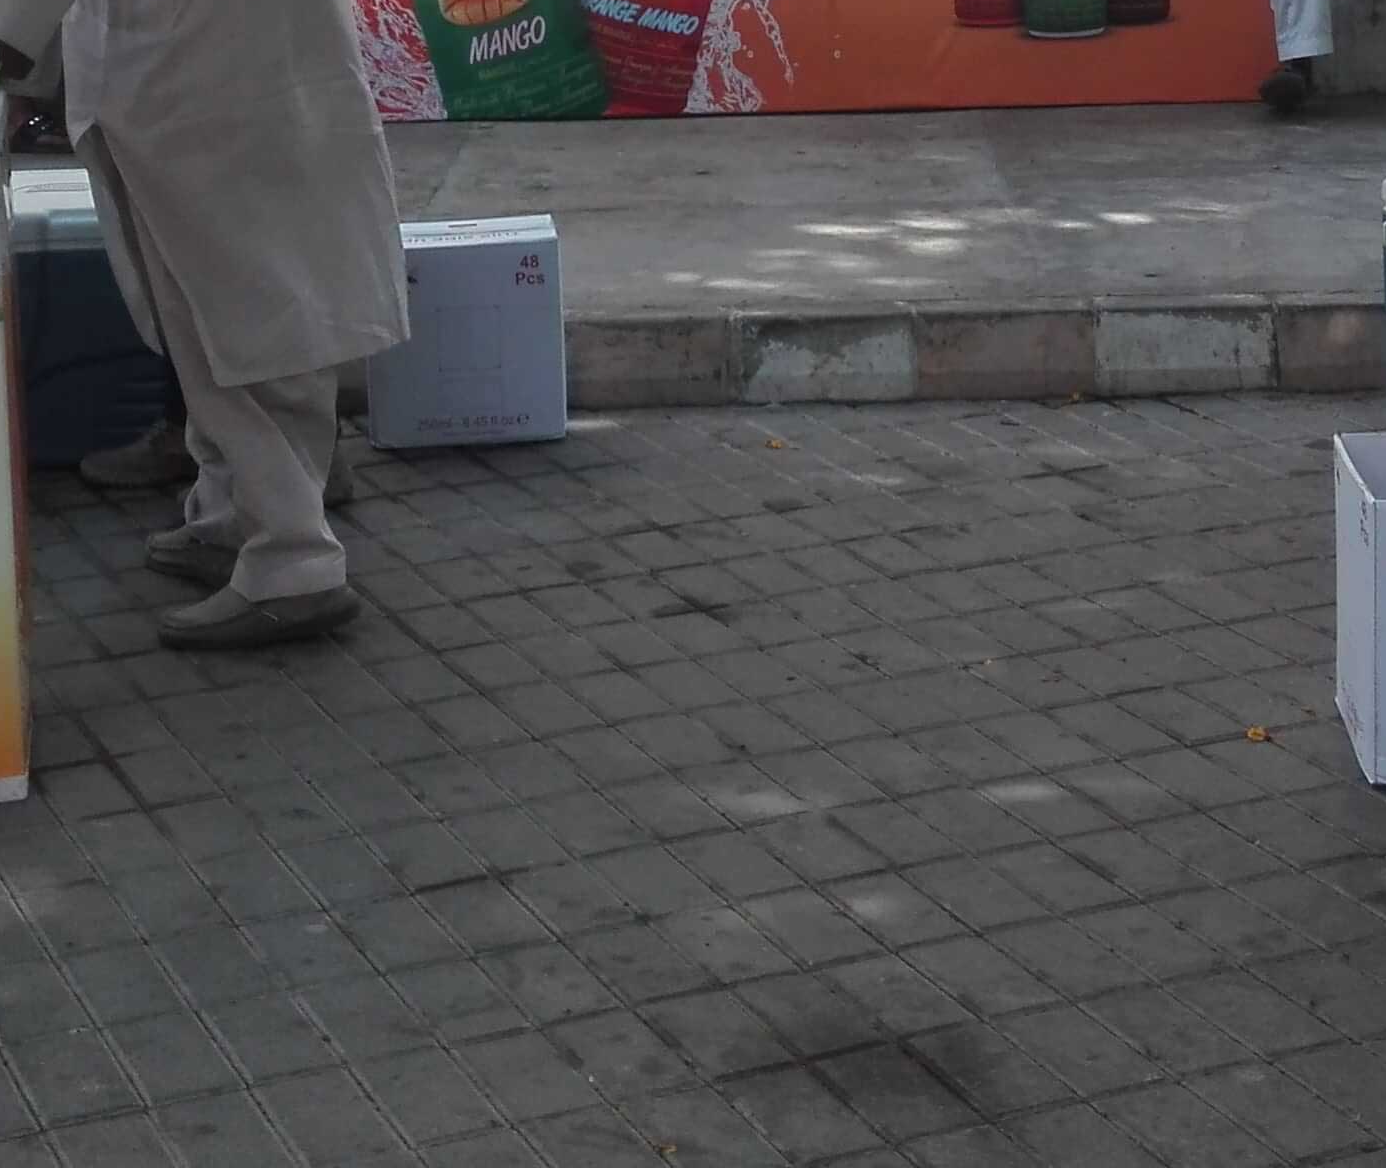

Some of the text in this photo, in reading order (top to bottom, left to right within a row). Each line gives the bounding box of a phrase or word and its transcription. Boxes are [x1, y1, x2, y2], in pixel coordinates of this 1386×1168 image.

[637, 7, 700, 36] MANGO
[469, 15, 547, 64] MANGO
[520, 255, 540, 269] 48
[514, 271, 545, 286] Pcs
